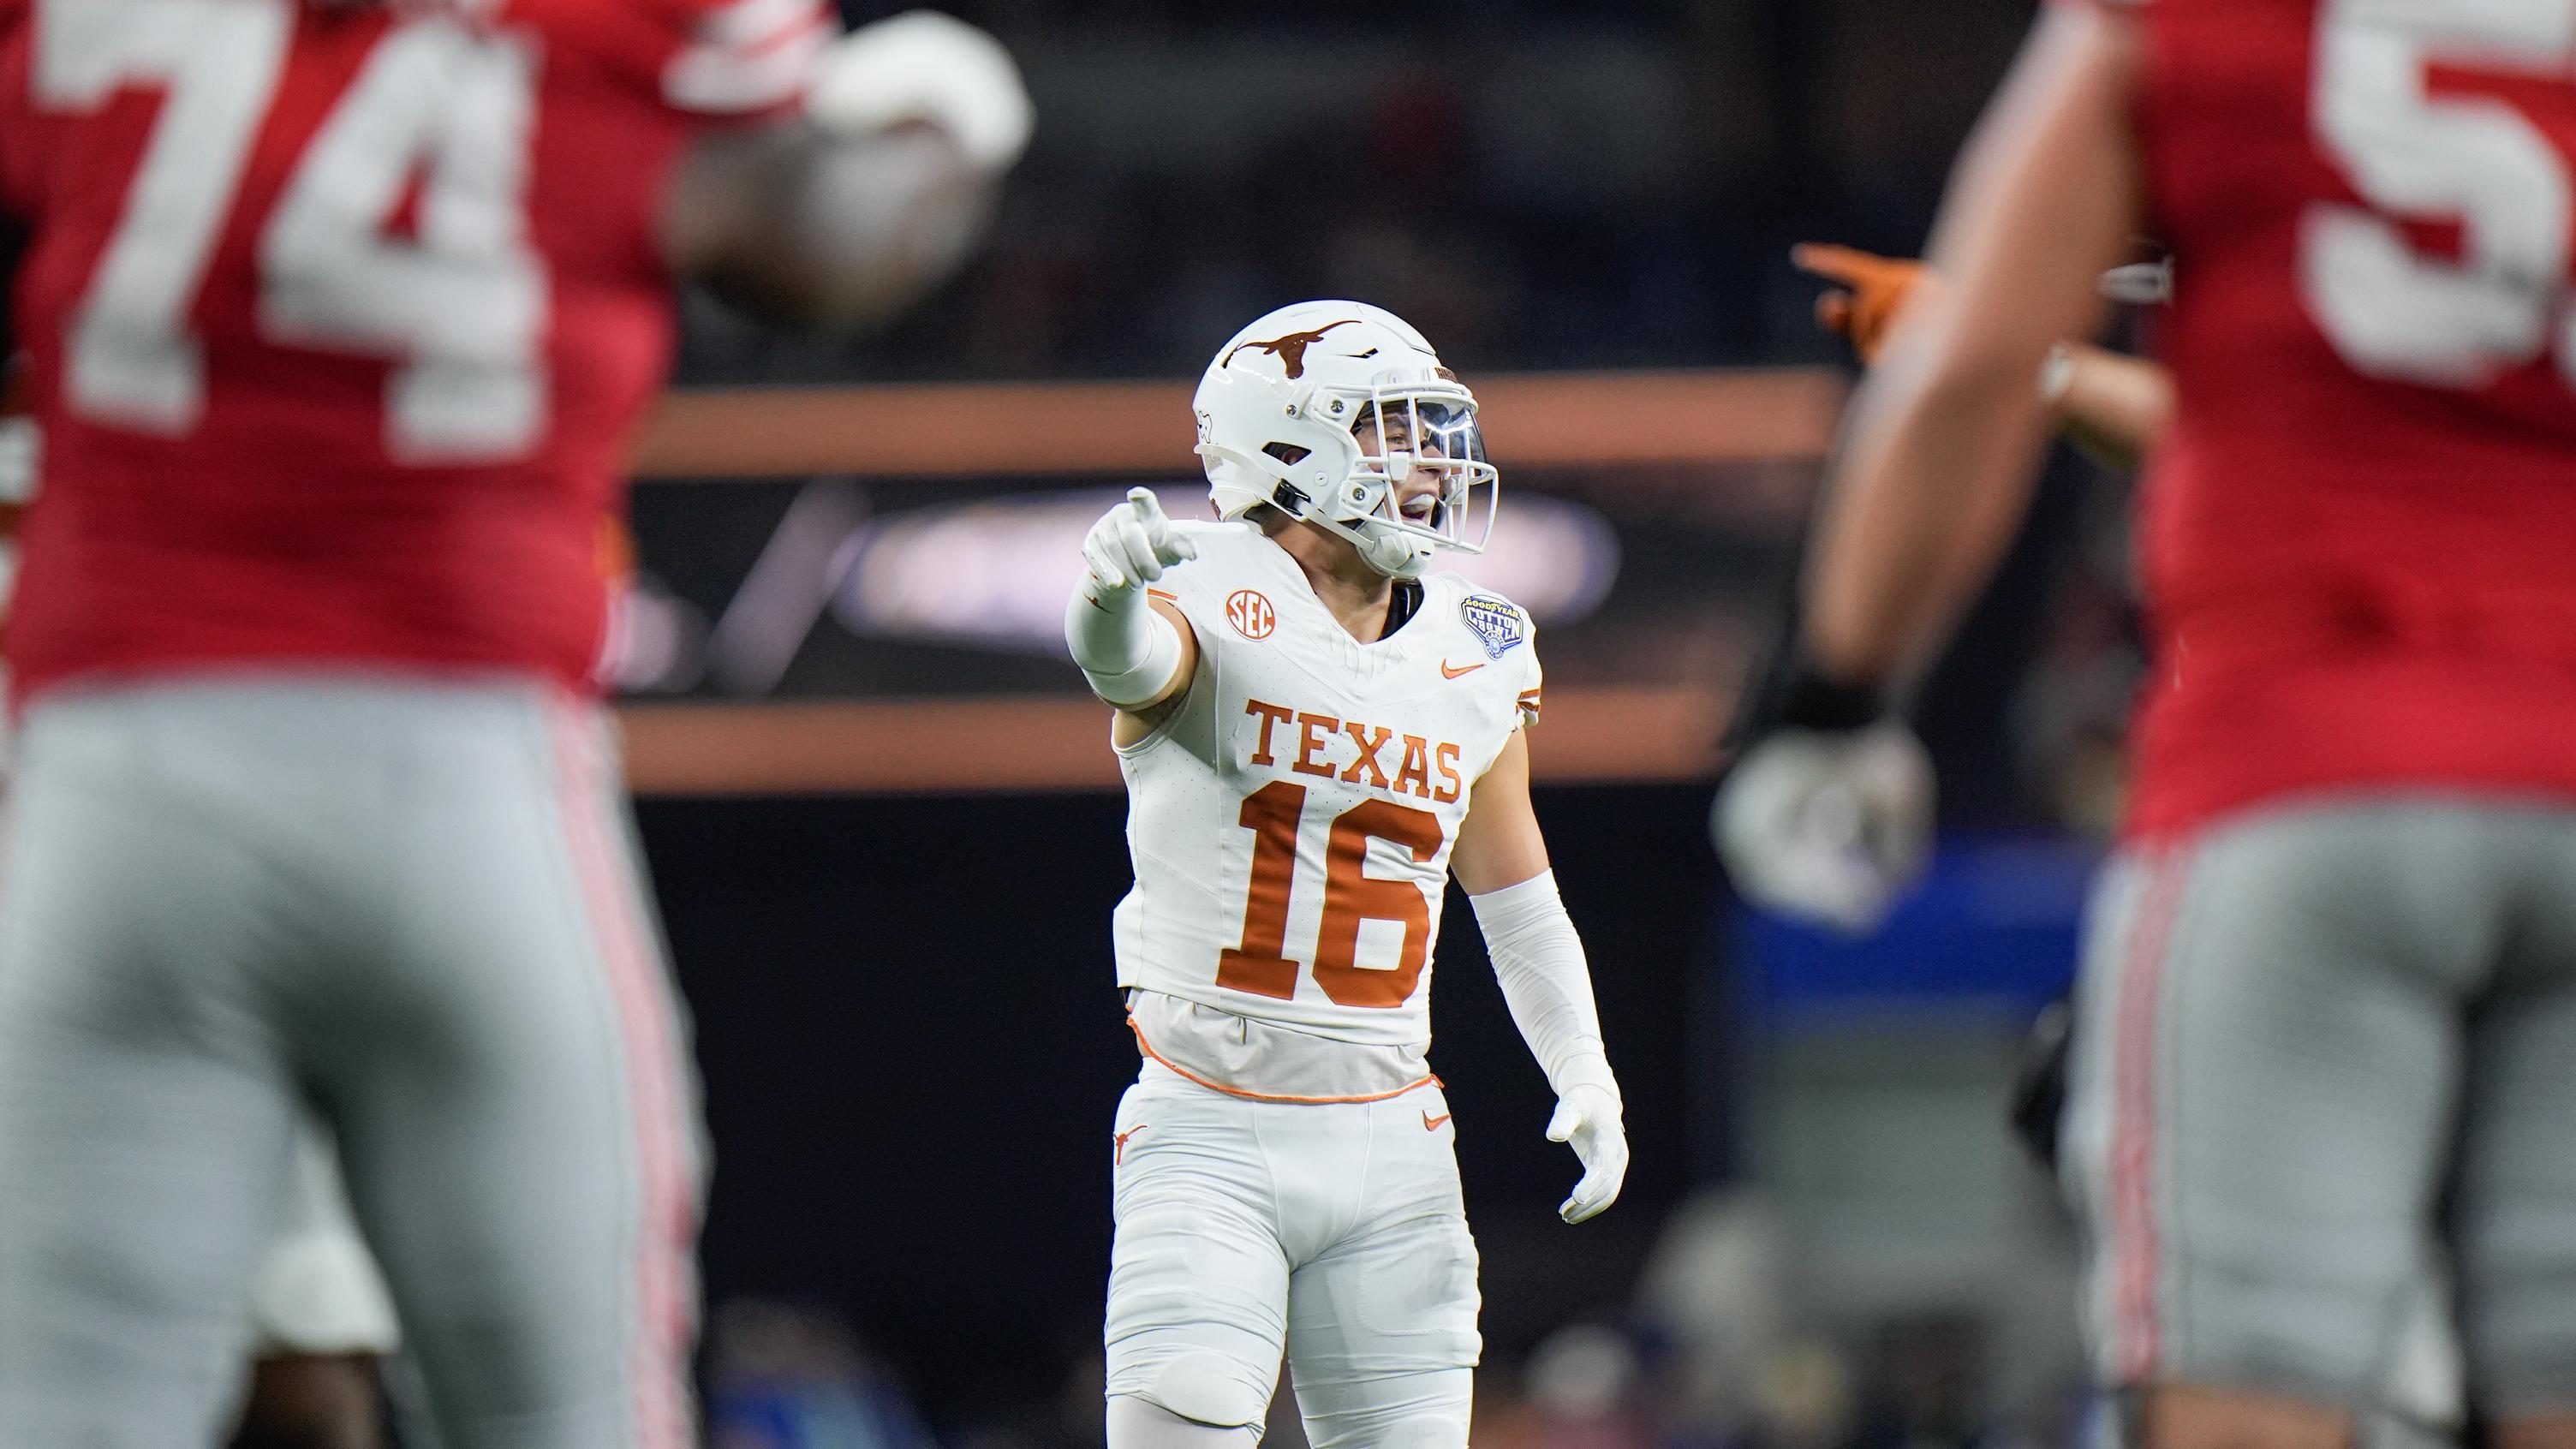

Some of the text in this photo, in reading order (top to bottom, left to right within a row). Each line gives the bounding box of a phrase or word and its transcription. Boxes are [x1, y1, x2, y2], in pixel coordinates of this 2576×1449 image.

[2299, 0, 2576, 391] 5
[26, 0, 551, 467] 74
[1227, 591, 1274, 637] SEC
[1465, 599, 1519, 617] GOODYEAR
[1466, 607, 1520, 640] COTTON
[1478, 619, 1512, 641] BOWL
[1246, 699, 1460, 804] TEXAS
[1216, 780, 1444, 1008] 16
